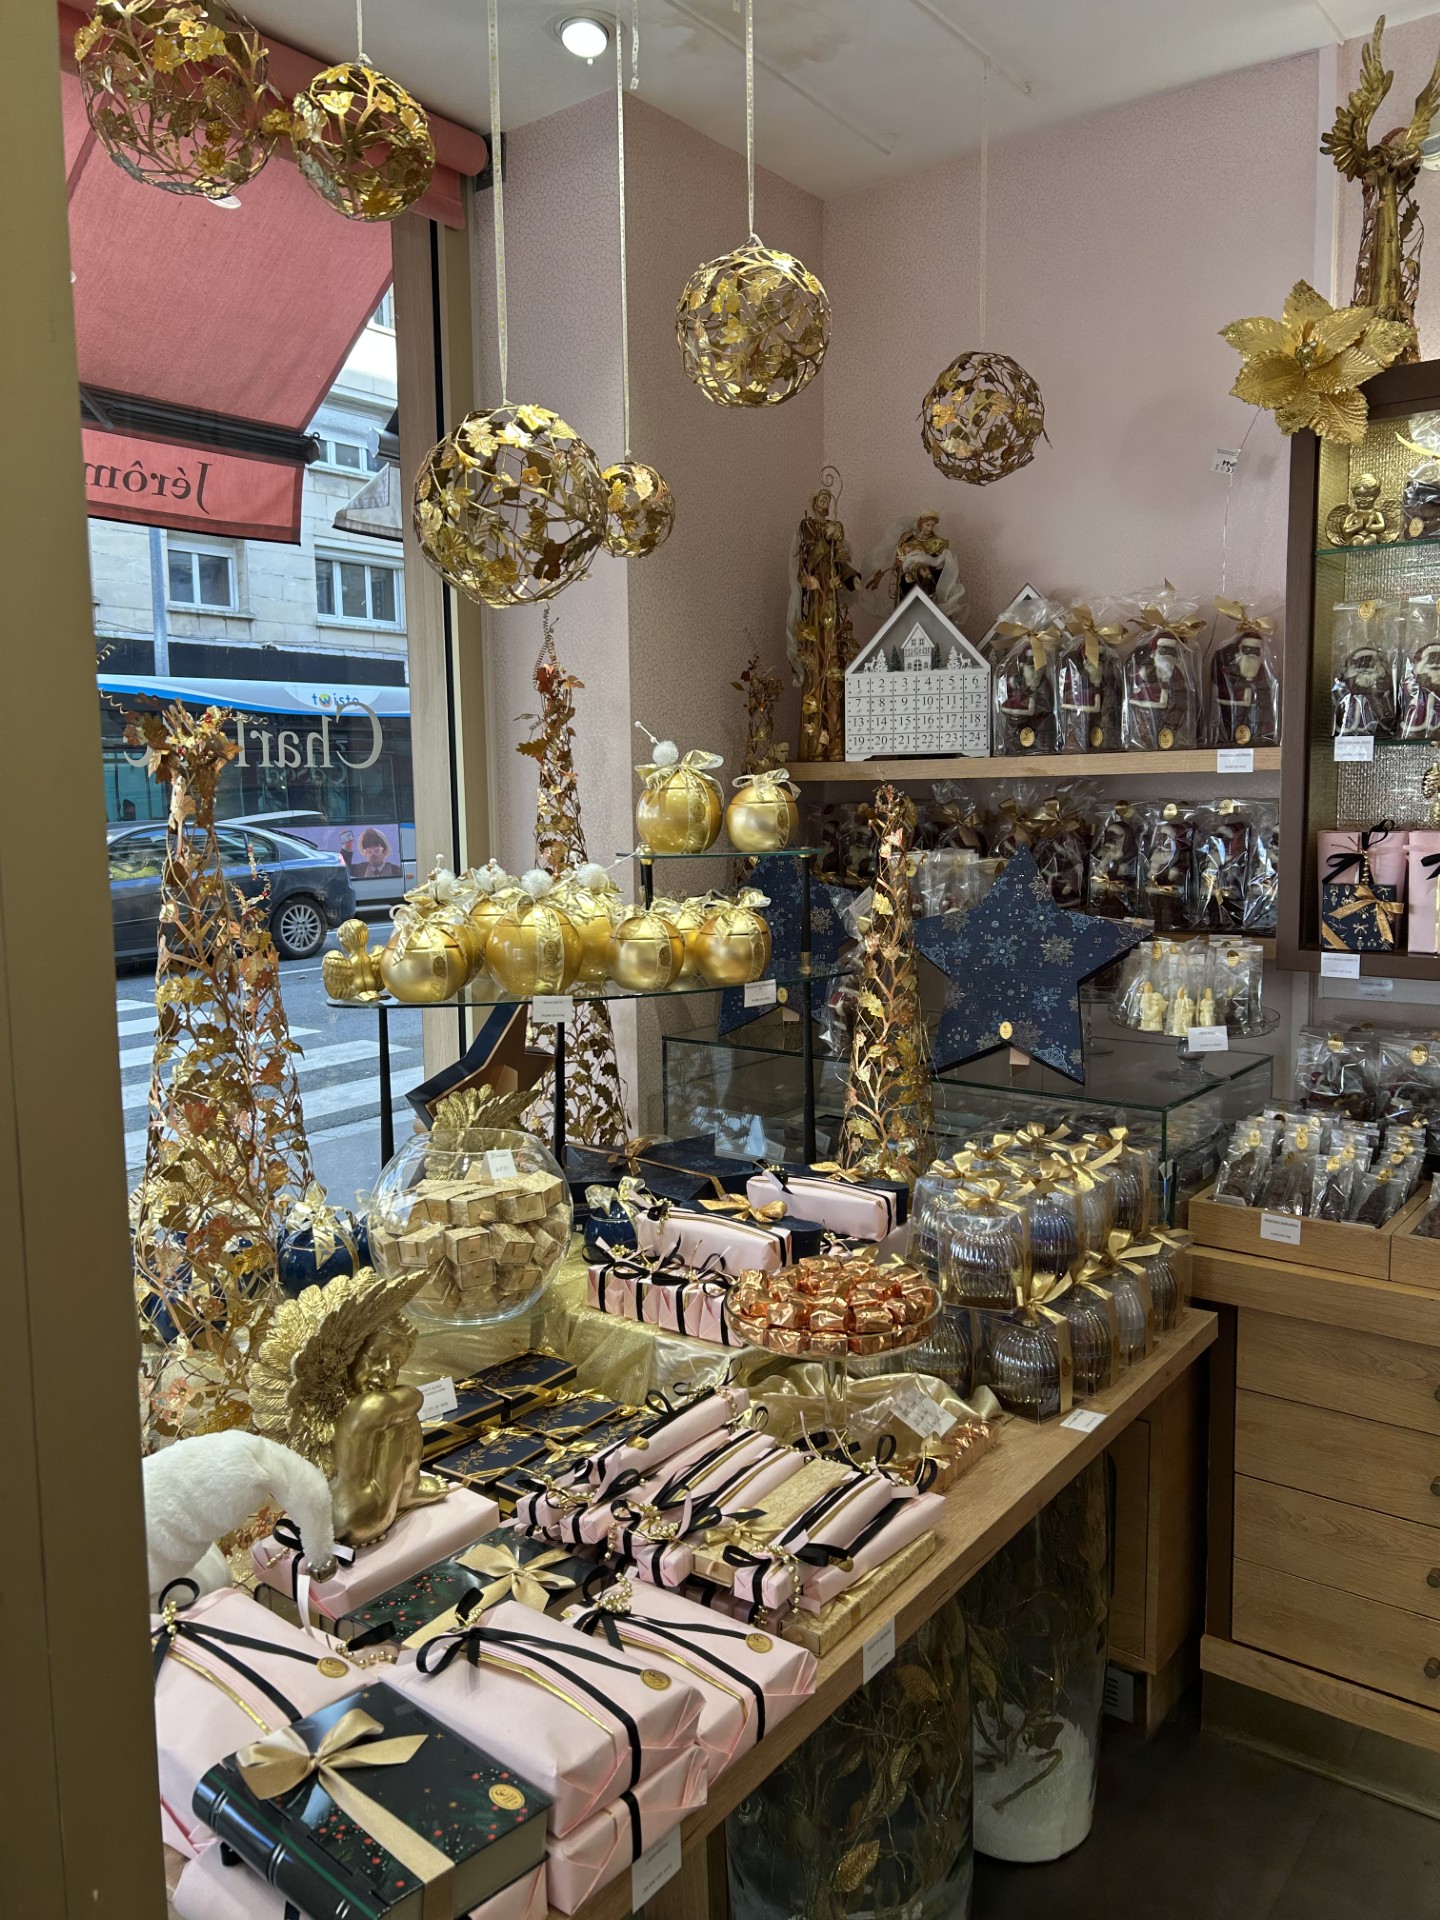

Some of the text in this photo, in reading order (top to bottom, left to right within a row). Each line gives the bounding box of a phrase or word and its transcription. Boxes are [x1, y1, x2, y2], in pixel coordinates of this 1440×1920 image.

[878, 678, 885, 688] 2
[902, 677, 908, 687] 3
[924, 676, 932, 686] 4
[948, 675, 955, 686] 5
[972, 675, 979, 685] 6
[855, 694, 982, 708] 7 8 9 10 11 12
[853, 713, 981, 727] 13 14 15 16 17 18
[853, 732, 981, 746] 19 20 21 22 23 24
